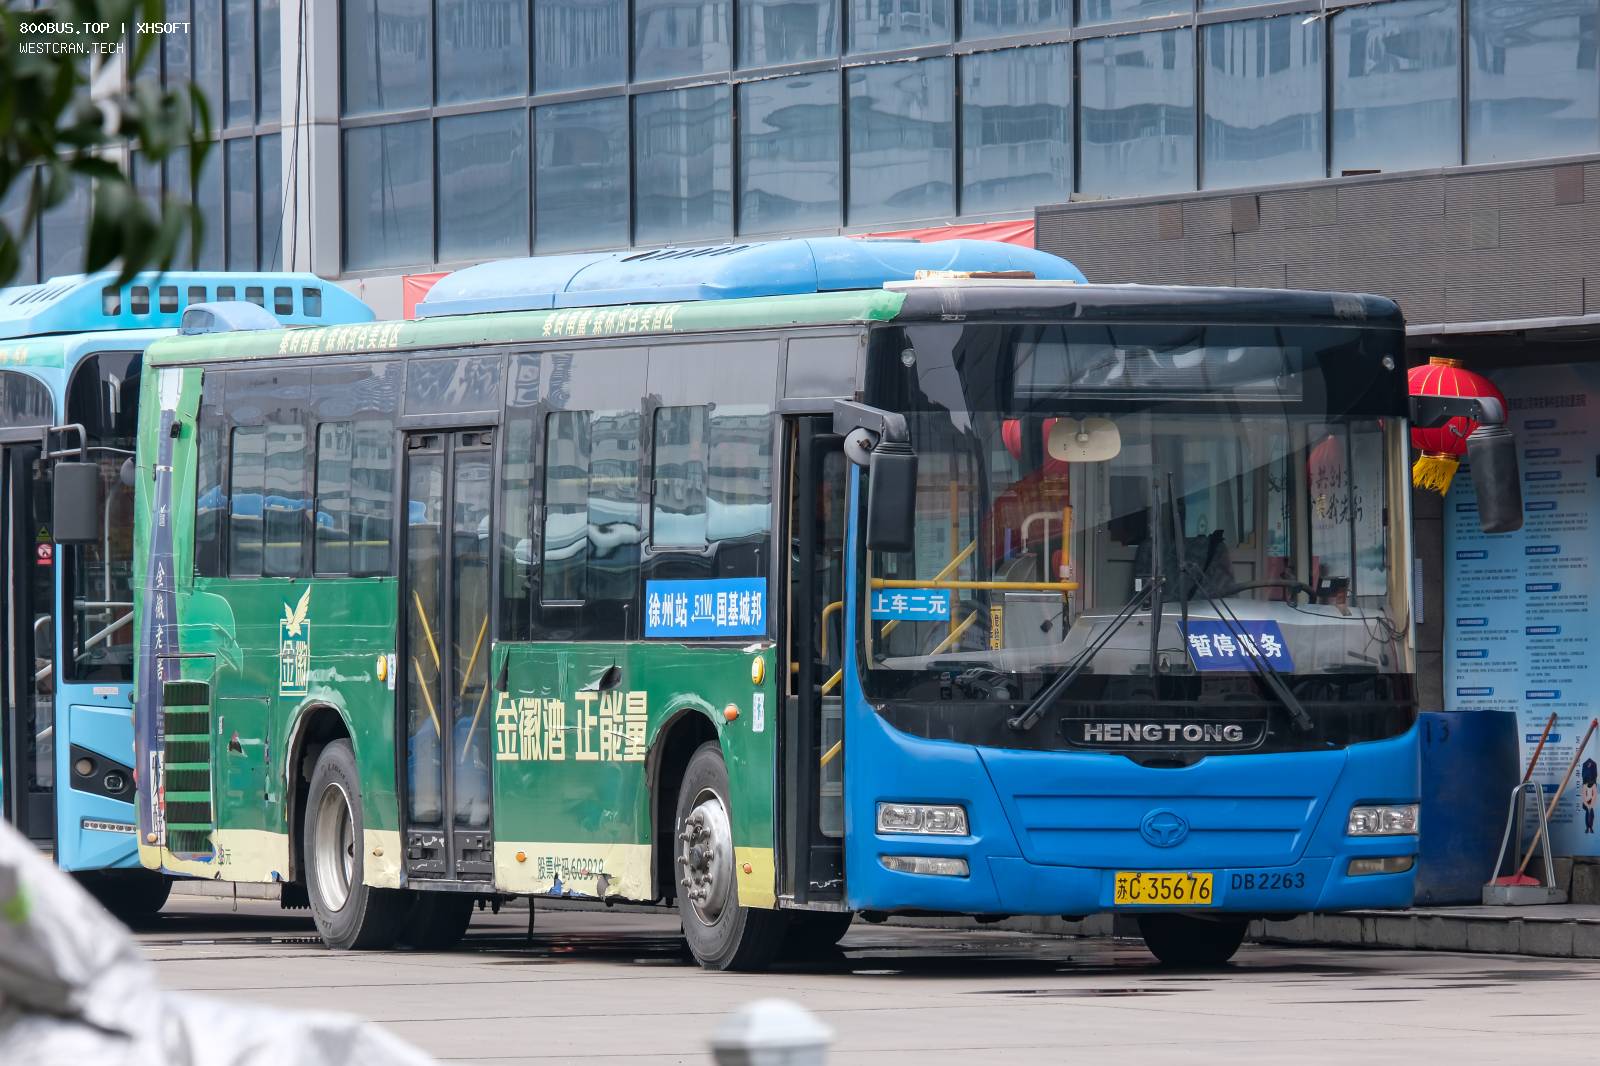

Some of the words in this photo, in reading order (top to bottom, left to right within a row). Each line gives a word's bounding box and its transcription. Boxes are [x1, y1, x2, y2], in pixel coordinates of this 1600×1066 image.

[648, 591, 689, 628] 徐州站
[694, 593, 713, 616] 51W
[716, 589, 762, 628] 国基城邦
[872, 593, 947, 614] 上车二元
[495, 691, 566, 761] 金徽酒
[574, 690, 649, 761] 正能量
[1083, 723, 1244, 742] HENGTONG
[1231, 872, 1306, 891] DB2263
